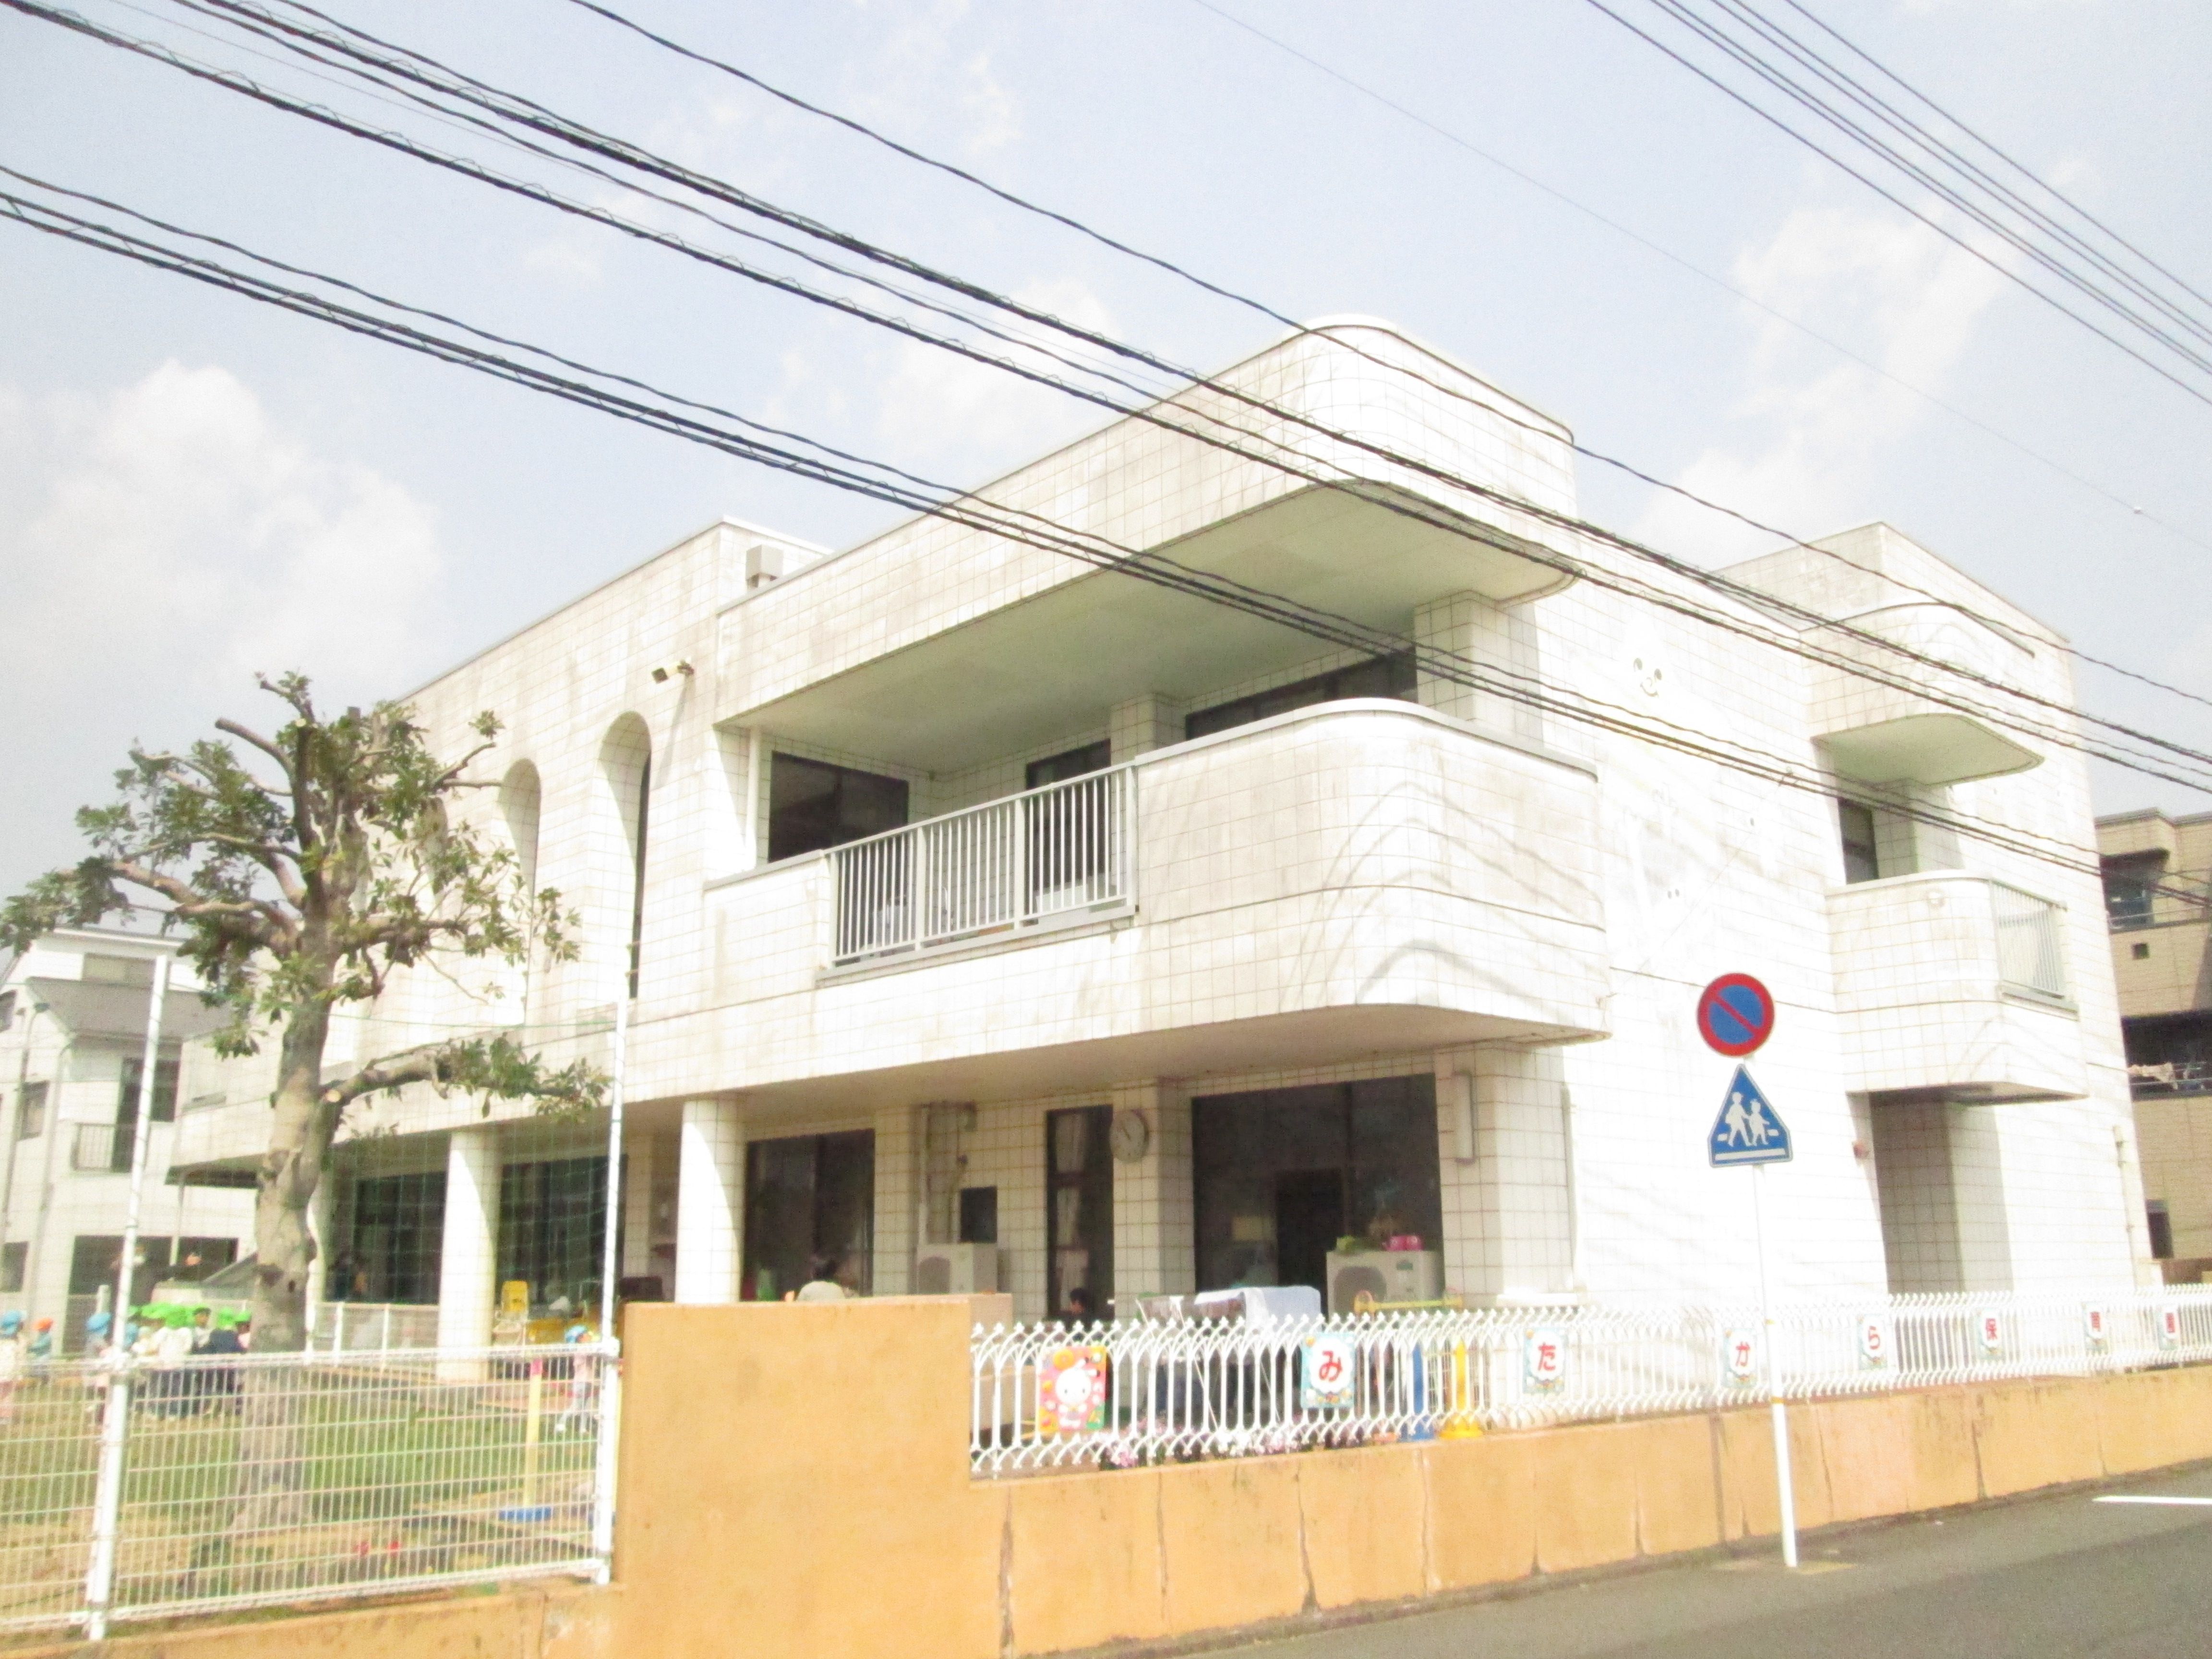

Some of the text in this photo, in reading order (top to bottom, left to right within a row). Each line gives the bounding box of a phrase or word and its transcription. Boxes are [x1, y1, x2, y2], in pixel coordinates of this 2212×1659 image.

[1868, 1325, 1880, 1350] ら
[1319, 1350, 1343, 1382] み
[1538, 1342, 1556, 1371] た
[1736, 1341, 1750, 1367] か
